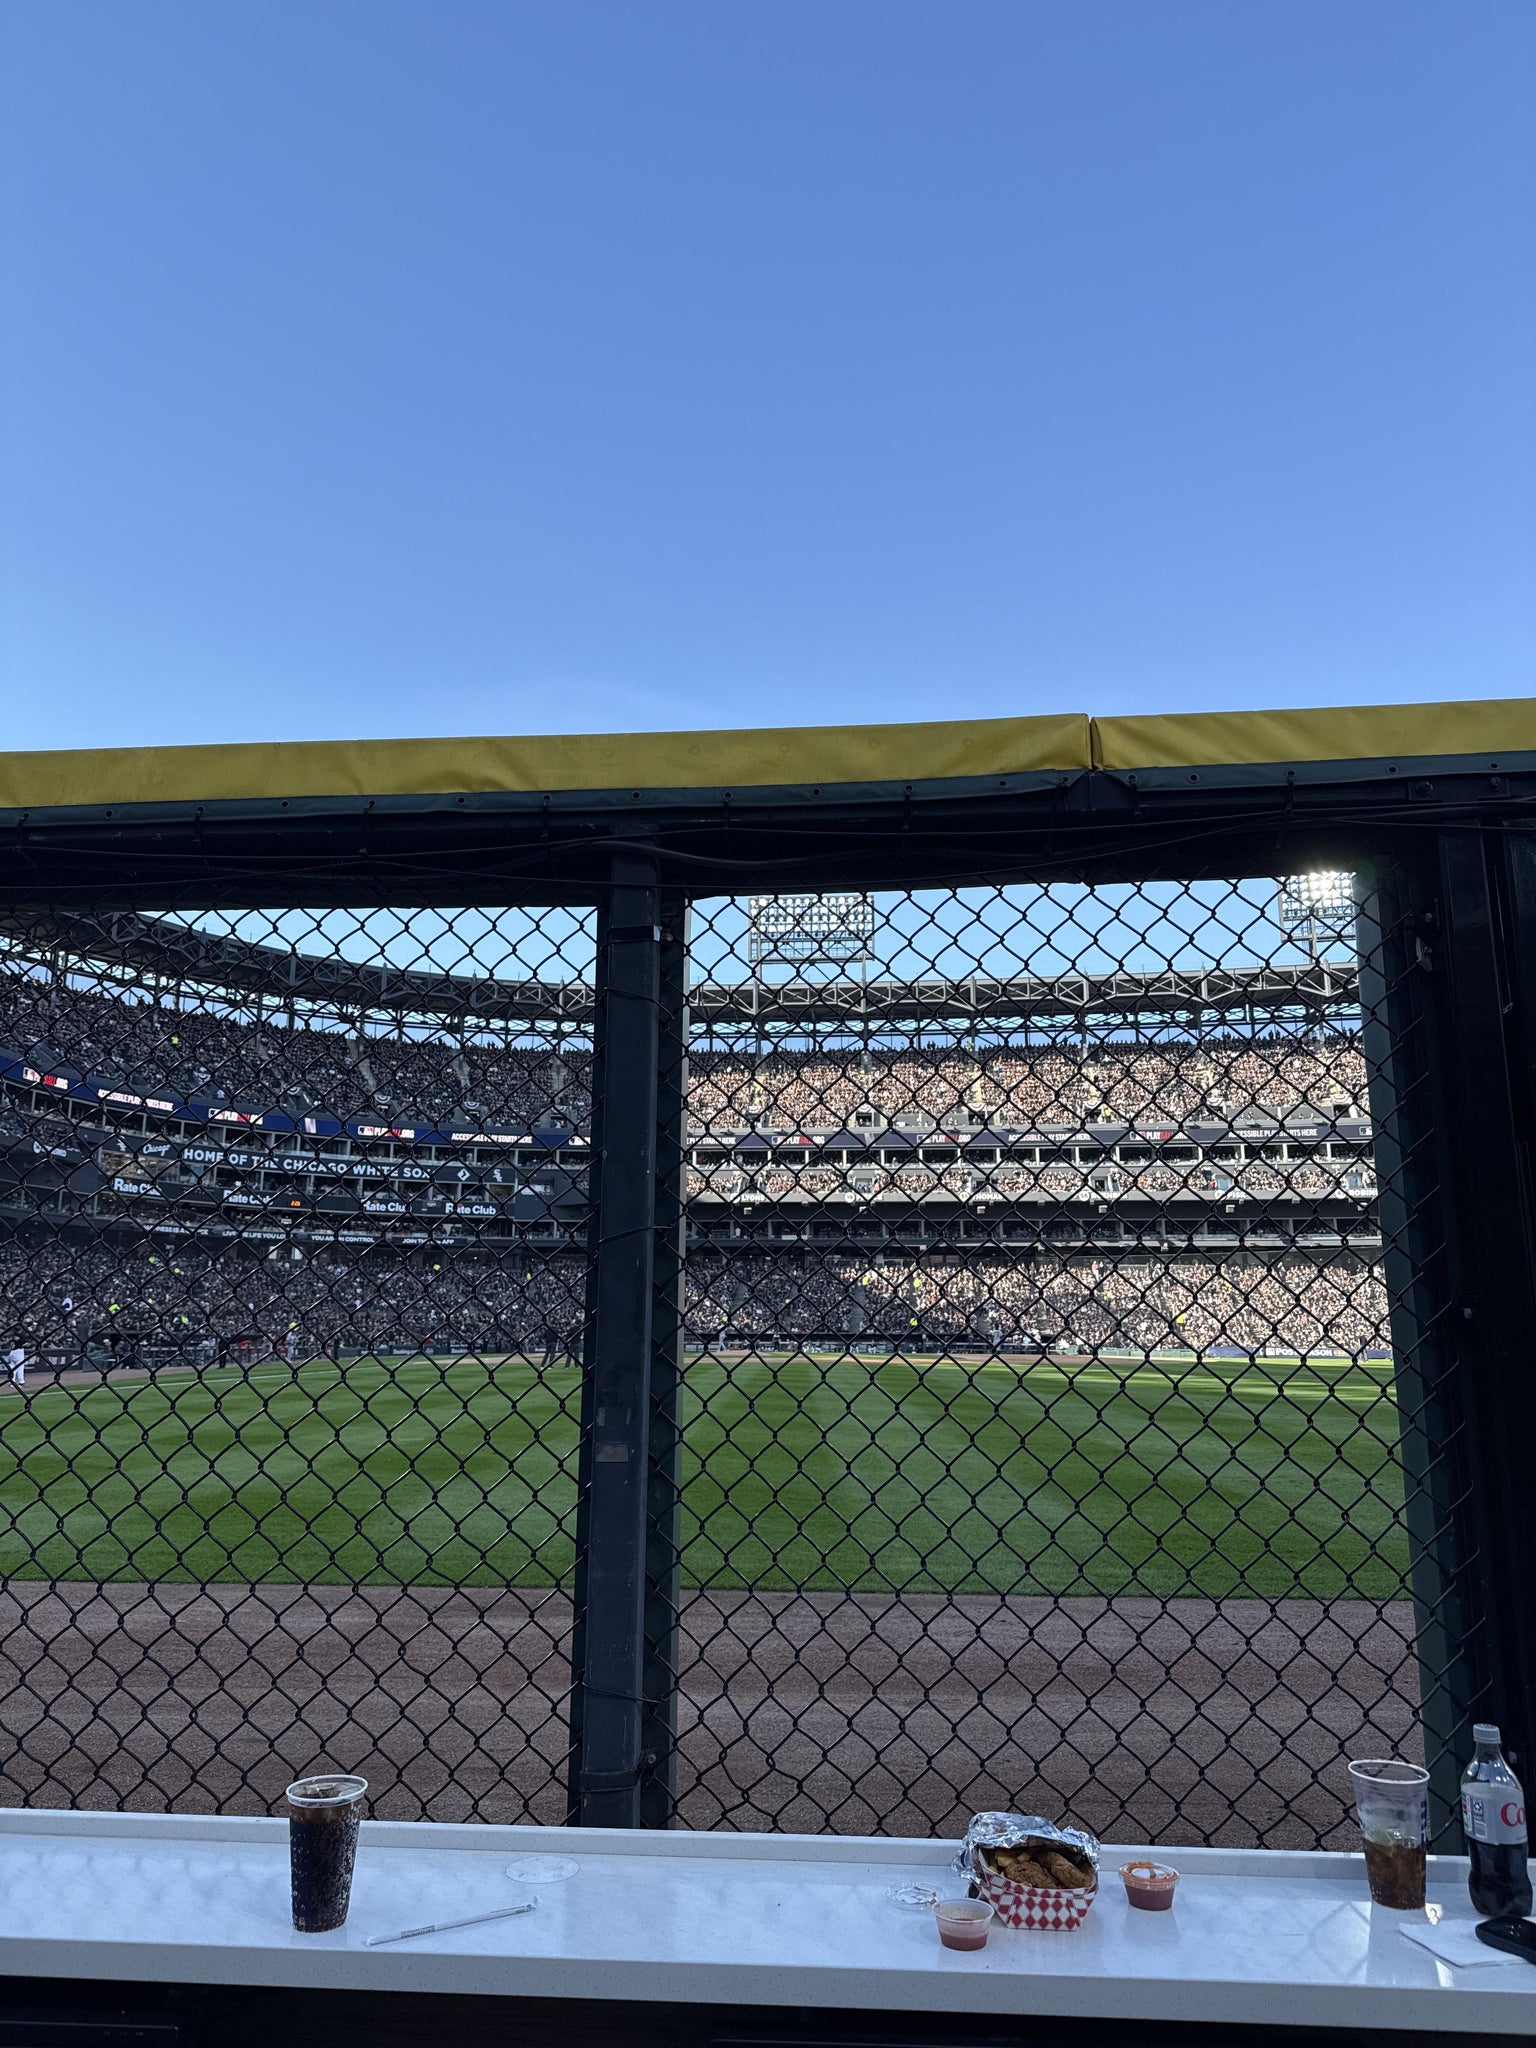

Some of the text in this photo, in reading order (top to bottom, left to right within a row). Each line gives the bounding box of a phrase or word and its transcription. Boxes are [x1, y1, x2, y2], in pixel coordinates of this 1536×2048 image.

[374, 1127, 415, 1139] PLAALL.ORG
[1008, 1133, 1041, 1142] ACESSIBLE
[1041, 1133, 1055, 1141] PAY
[788, 1135, 825, 1145] PLAYBA.ORG
[183, 1148, 431, 1179] HOME OF THE CHICAGO WHITE SOX
[113, 1178, 138, 1193] Rate
[223, 1189, 249, 1204] Rate
[387, 1202, 408, 1213] Clu
[472, 1205, 496, 1216] Club
[1275, 1347, 1333, 1357] POSTASON
